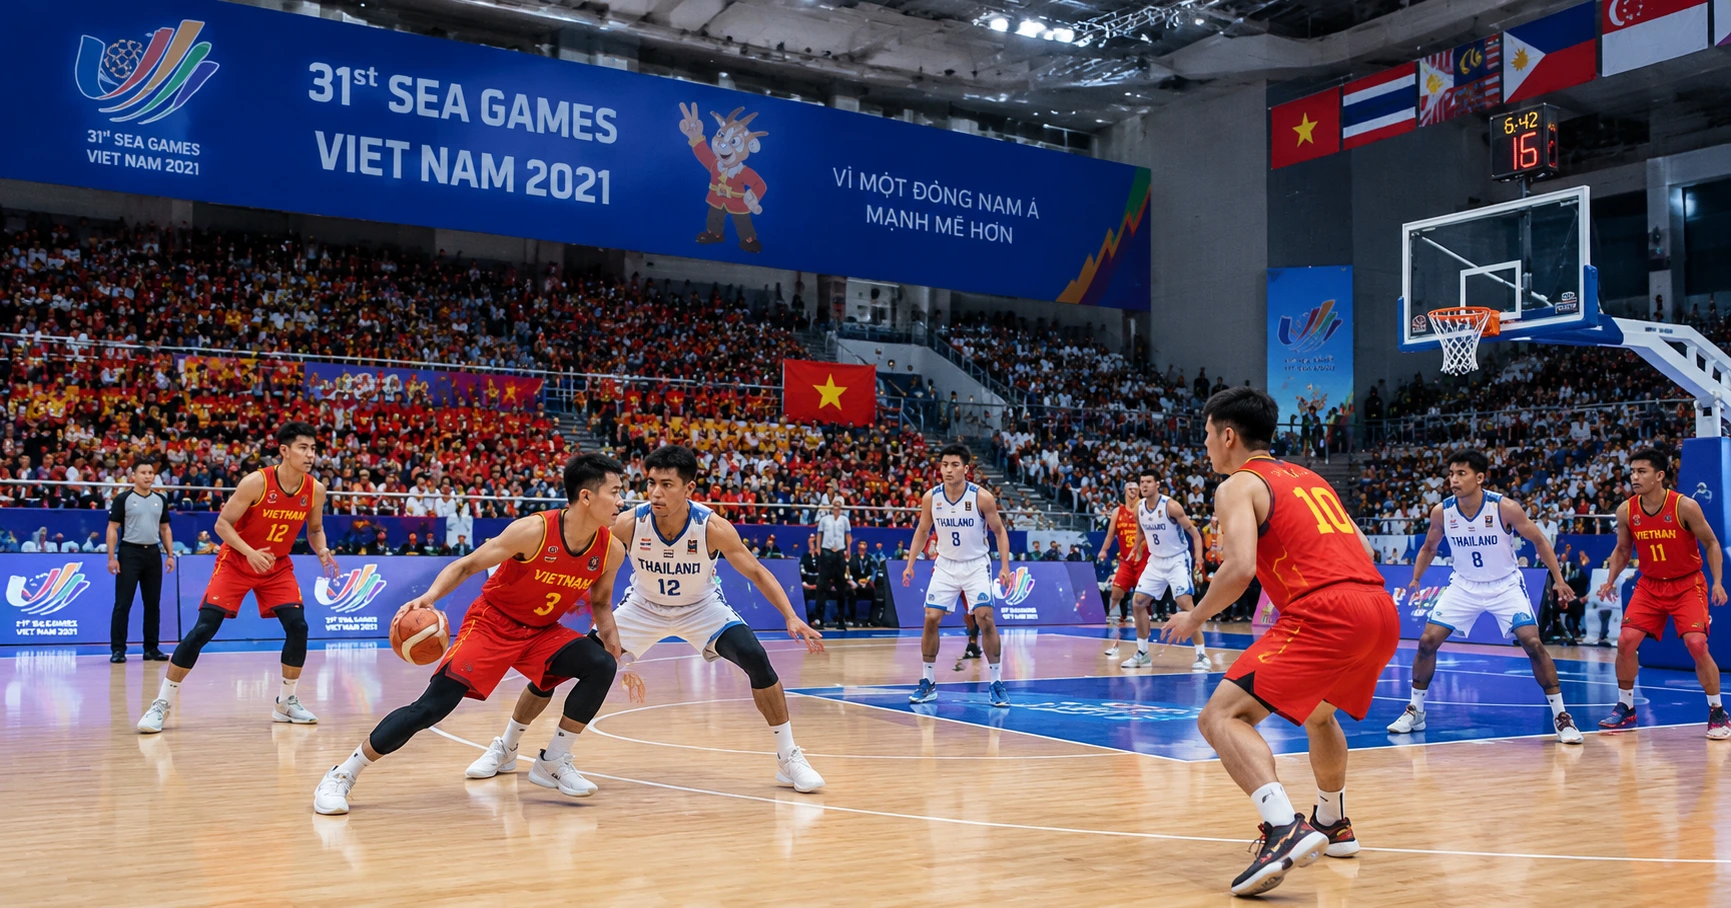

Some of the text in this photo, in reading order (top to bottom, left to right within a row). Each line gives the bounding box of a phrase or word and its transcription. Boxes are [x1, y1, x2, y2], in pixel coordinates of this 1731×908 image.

[308, 62, 618, 144] 31st SEA GAMES
[114, 133, 144, 149] SEA
[147, 138, 200, 156] GAMES
[86, 149, 199, 175] VIET NAM 2021
[315, 130, 610, 205] VIET NAM 2021
[978, 192, 1021, 217] NAM
[866, 204, 928, 231] MẠNH
[970, 221, 1013, 244] HƠN
[1293, 486, 1354, 534] 10
[266, 523, 289, 543] 12
[951, 531, 961, 546] 8
[1153, 533, 1160, 545] 8
[1471, 551, 1483, 567] 8
[1650, 543, 1666, 561] 11
[658, 578, 681, 596] 12
[533, 592, 561, 616] 3
